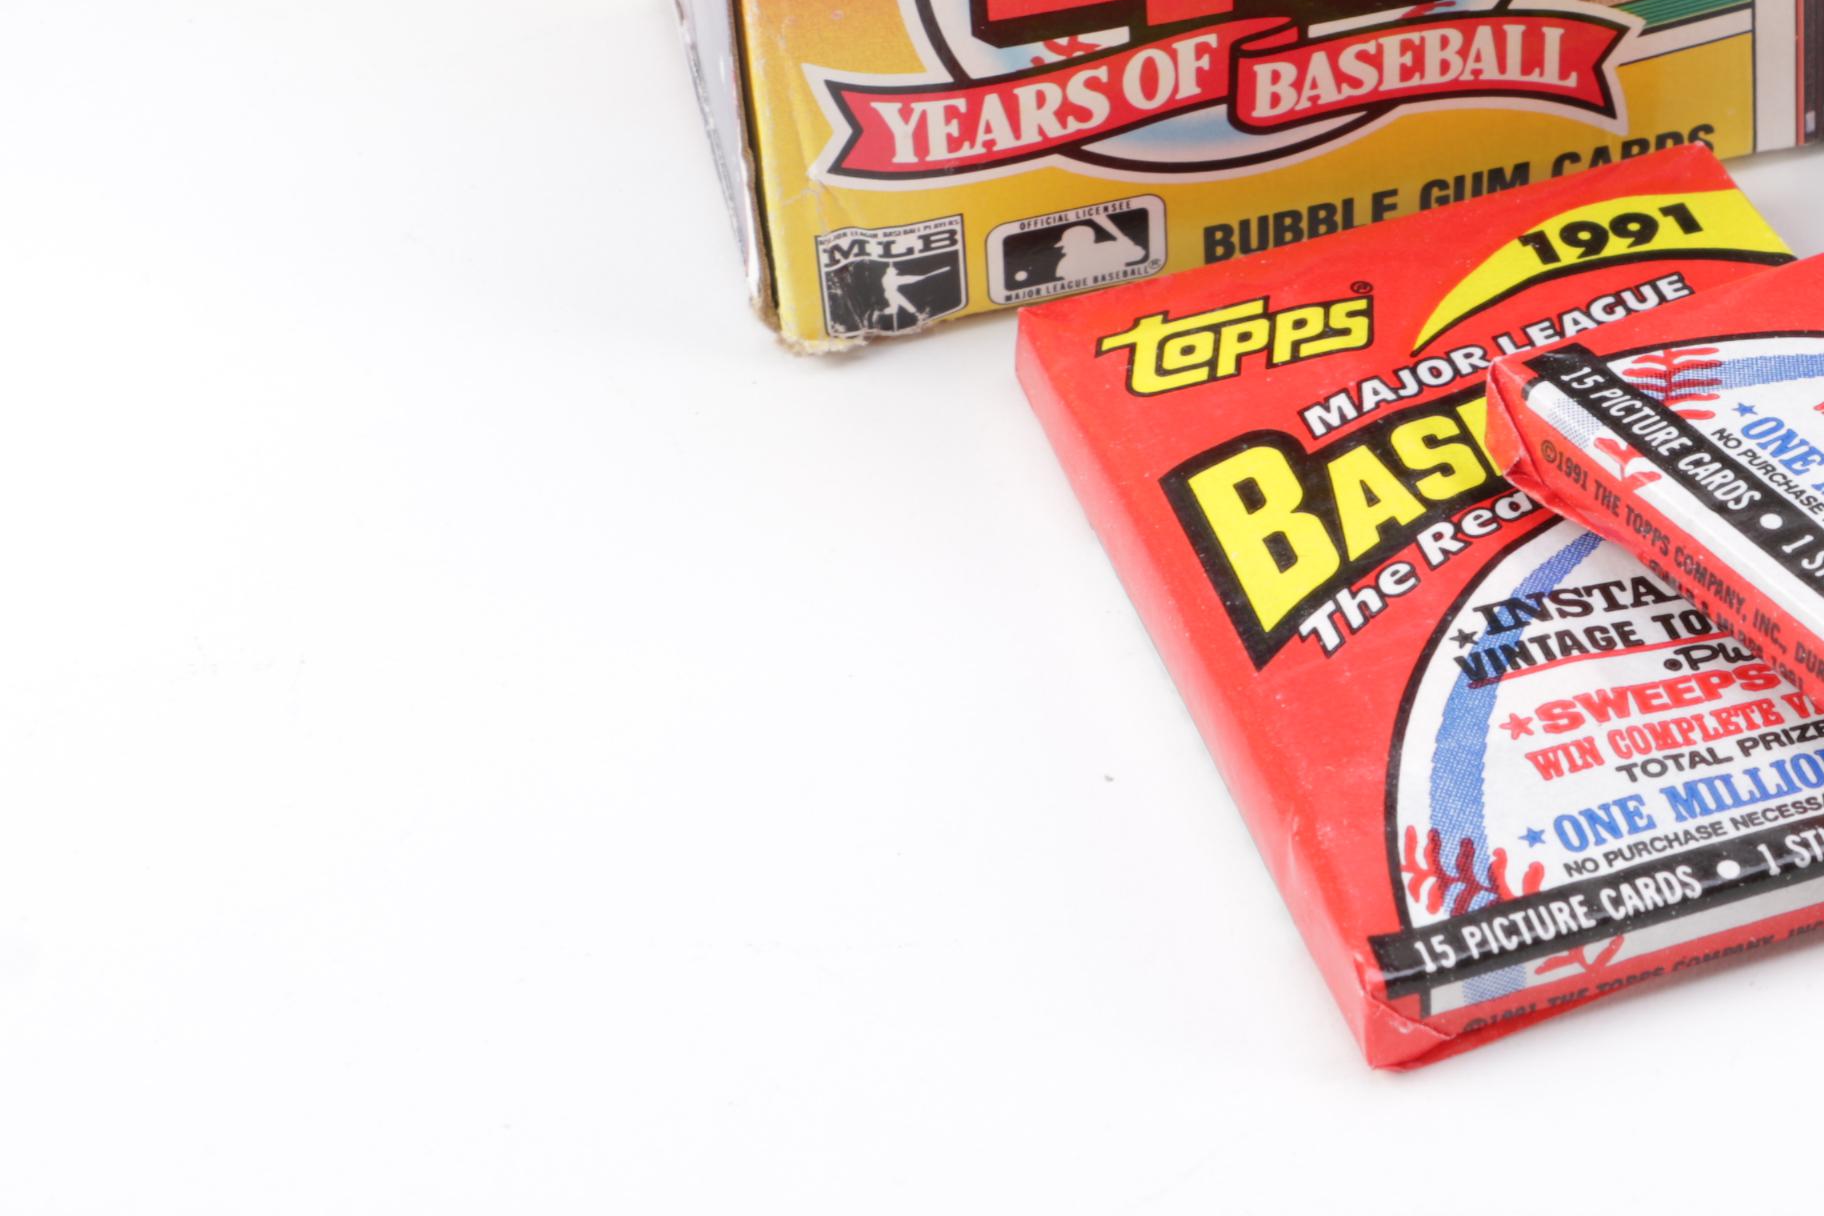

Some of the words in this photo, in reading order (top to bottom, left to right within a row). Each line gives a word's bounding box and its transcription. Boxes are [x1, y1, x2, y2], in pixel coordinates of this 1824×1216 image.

[870, 70, 1110, 163] YEARS
[1121, 34, 1220, 109] OF
[1252, 24, 1579, 117] BASEBALL
[1019, 214, 1069, 231] OFFICIAL
[1075, 201, 1131, 220] LICENSEE
[1203, 190, 1398, 265] BUBBLE
[1519, 202, 1705, 265] 1991
[824, 230, 958, 268] MLB
[1005, 288, 1041, 302] MAJOR
[1046, 278, 1088, 295] LEAGUE
[1093, 268, 1148, 286] BASEBALL
[1303, 343, 1494, 438] MAJOR
[1500, 273, 1694, 355] LEAGUE
[1561, 366, 1600, 397] 15
[1601, 383, 1681, 458] PICTURE
[1679, 452, 1764, 512] CARDS
[1711, 428, 1743, 451] NO
[1541, 441, 1589, 483] ©1991
[1593, 480, 1622, 518] THE
[1624, 503, 1672, 561] TOPPS
[1672, 537, 1748, 624] COMPANY,
[1300, 558, 1418, 658] The
[1454, 625, 1645, 686] VINTAGE
[1526, 743, 1602, 780] WIN
[1607, 705, 1773, 766] COMPLETE
[1616, 741, 1731, 786] TOTAL
[1554, 804, 1655, 855] ONE
[1604, 822, 1728, 868] PURCHASE
[1415, 937, 1455, 973] 15
[1462, 900, 1589, 953] PICTURE
[1602, 865, 1701, 919] CARDS
